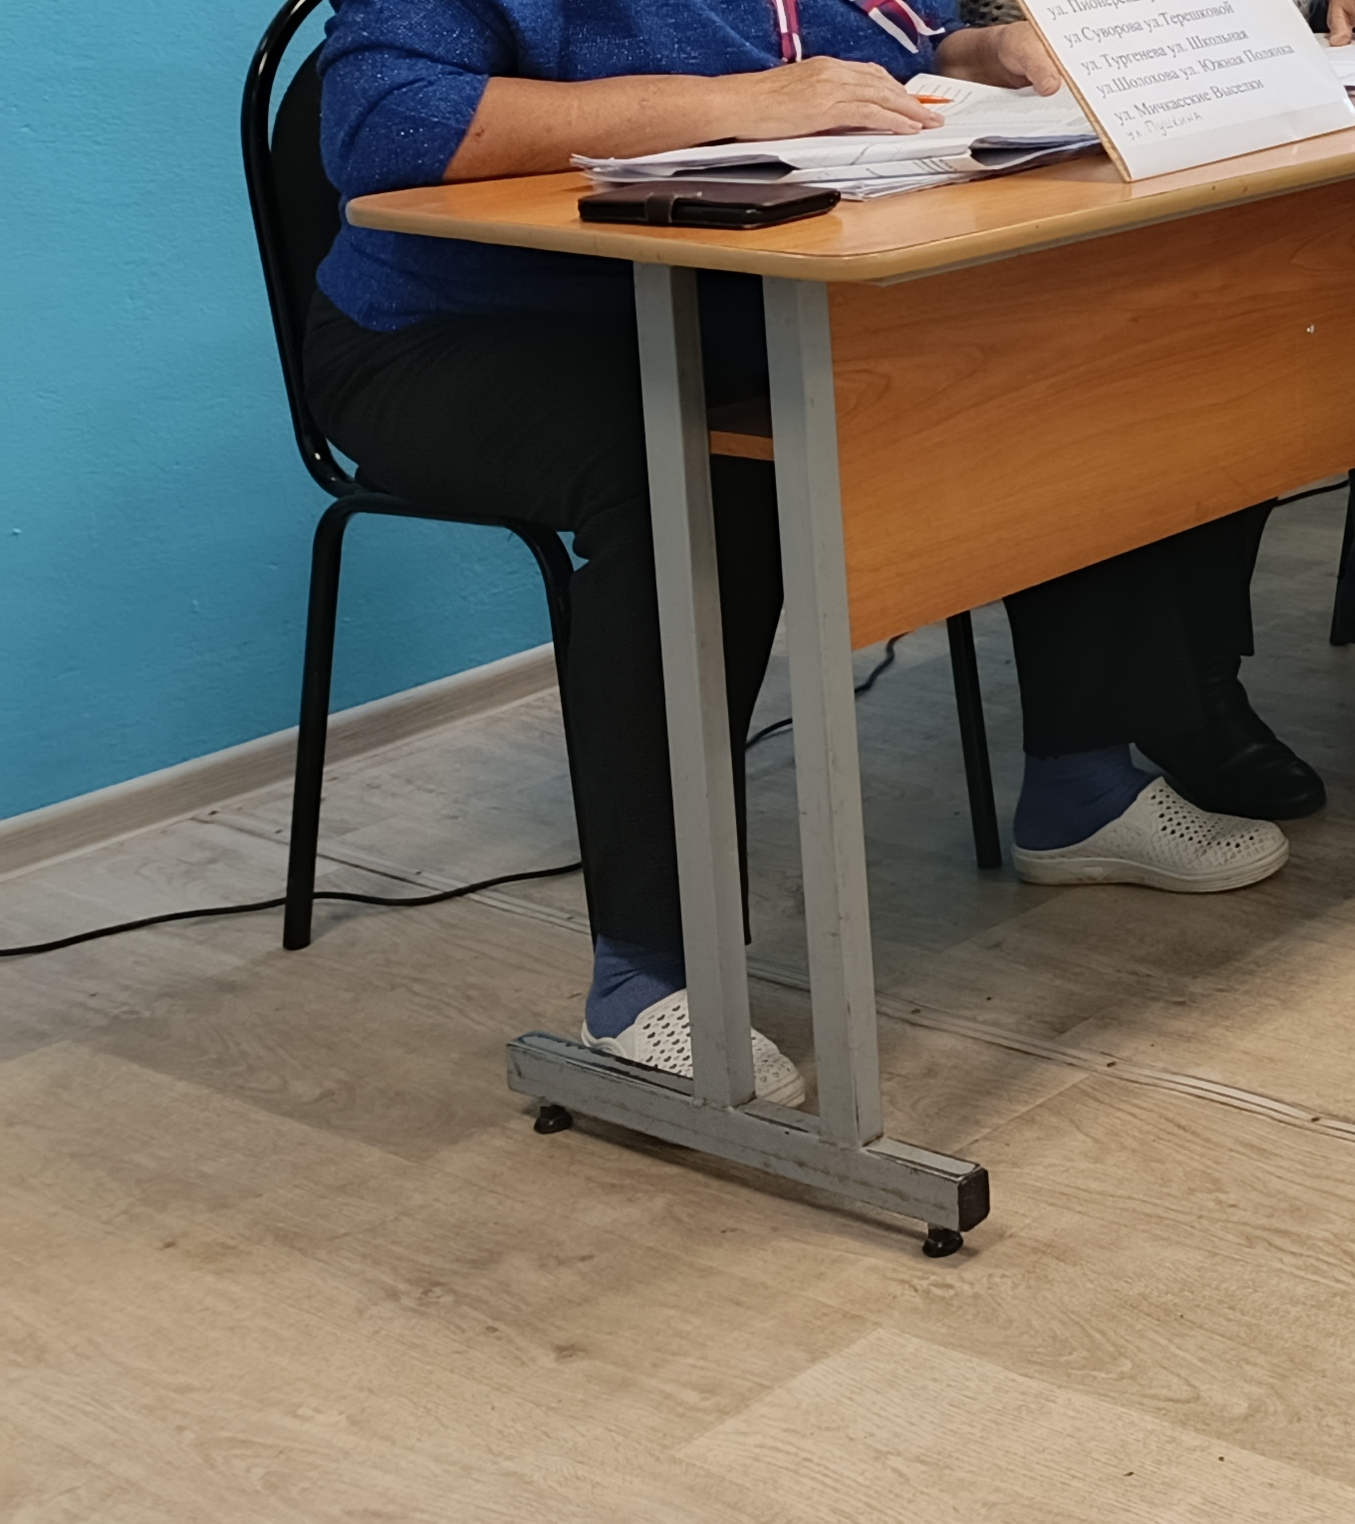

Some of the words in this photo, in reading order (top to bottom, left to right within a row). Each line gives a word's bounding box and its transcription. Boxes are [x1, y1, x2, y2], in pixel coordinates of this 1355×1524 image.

[1047, 5, 1069, 21] ул.
[1081, 20, 1144, 43] Суворова
[1081, 60, 1102, 76] ул.
[1099, 45, 1168, 70] Тургенева
[1167, 42, 1188, 58] ул.
[1185, 28, 1250, 50] Школьная
[1179, 66, 1200, 82] ул.
[1198, 54, 1245, 73] Южная
[1243, 43, 1296, 63] Полянка
[1113, 110, 1136, 126] ул.
[1134, 90, 1212, 118] Мичкасские
[1209, 78, 1265, 99] Выселки
